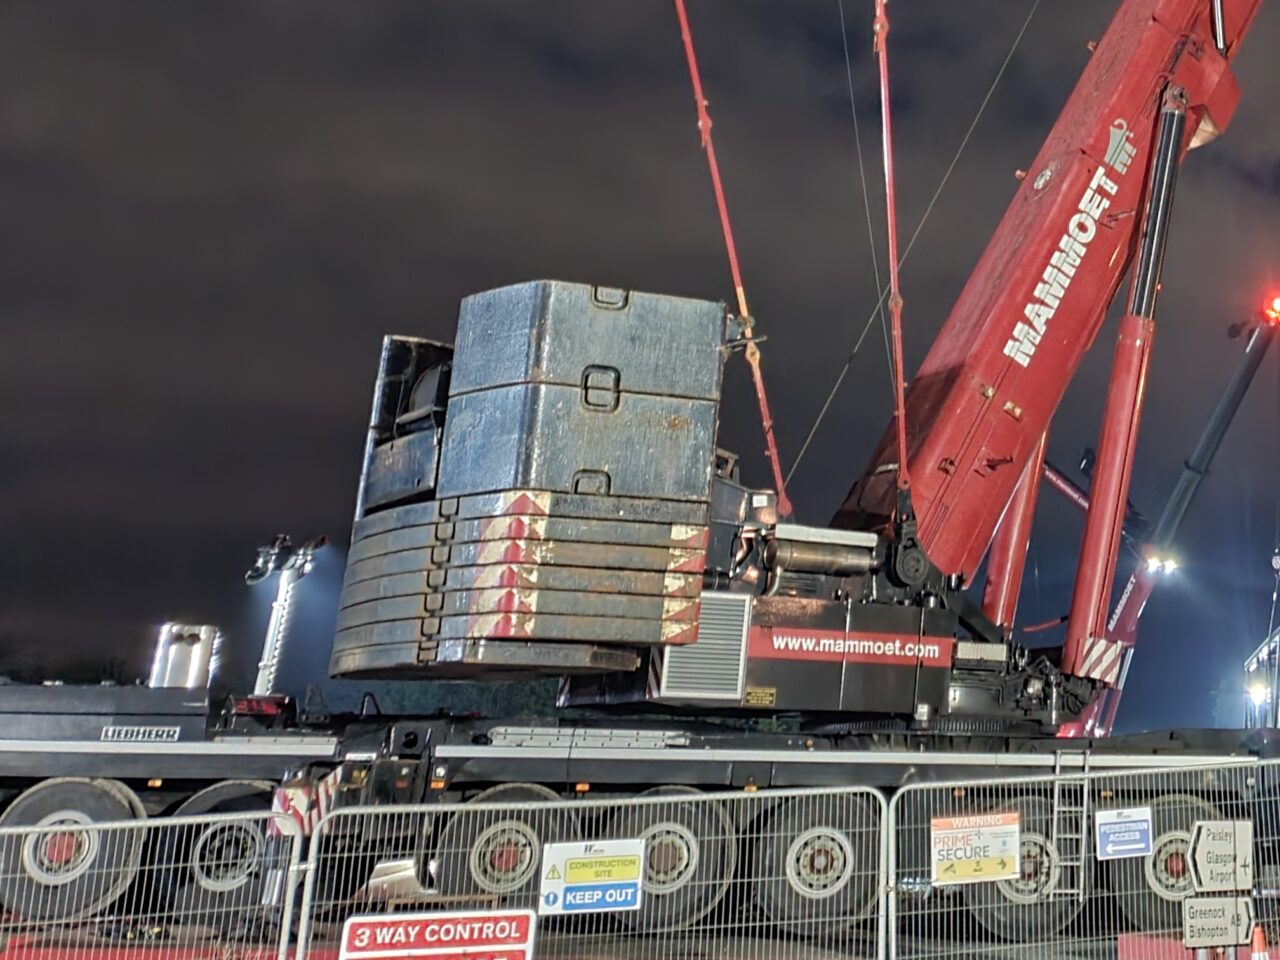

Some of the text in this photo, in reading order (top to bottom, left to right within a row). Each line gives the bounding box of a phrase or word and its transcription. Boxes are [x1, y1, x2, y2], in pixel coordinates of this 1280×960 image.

[1003, 166, 1119, 368] MAMMOET
[1107, 574, 1136, 632] MAMMOET
[772, 635, 940, 659] www.mammoet.com
[101, 726, 180, 741] LIEBHERR
[951, 815, 1003, 830] WARNING
[933, 834, 973, 849] PRIME
[1206, 828, 1232, 844] Paisley
[937, 845, 990, 861] SECURE
[569, 858, 638, 871] CONSTRUCTION
[594, 869, 613, 878] SITE
[565, 887, 636, 906] KEEP OUT
[1188, 905, 1226, 920] Greenock
[354, 920, 521, 948] 3 WAY CONTROL
[1189, 924, 1228, 940] Bishopton
